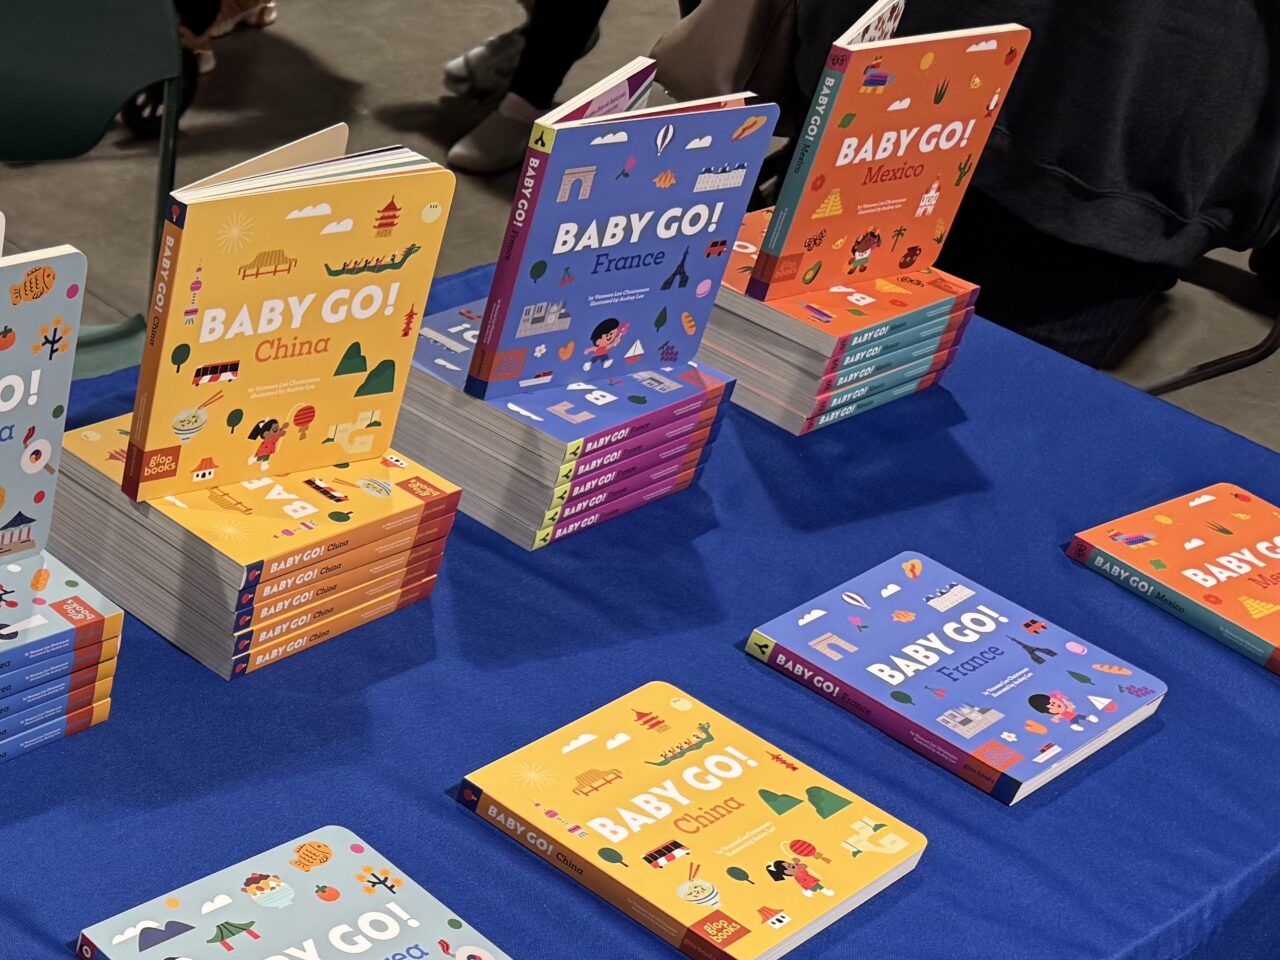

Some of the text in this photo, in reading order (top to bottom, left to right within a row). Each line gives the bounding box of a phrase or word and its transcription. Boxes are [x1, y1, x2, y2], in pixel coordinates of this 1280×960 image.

[795, 76, 835, 174] BABY GO! Mexico
[836, 119, 976, 167] BABY GO!
[861, 161, 925, 186] Mexico
[513, 156, 540, 227] BABY GO!
[552, 202, 724, 255] BABY GO!
[590, 250, 665, 275] France
[150, 235, 174, 346] BABY GO! China
[198, 282, 400, 343] BABY GO!
[255, 337, 331, 363] China
[852, 326, 889, 345] BABY GO!
[843, 346, 882, 365] BABY GO!
[837, 365, 875, 386] BABY GO!
[585, 436, 610, 452] BABY
[611, 428, 629, 442] GO!
[144, 463, 176, 476] books
[149, 453, 172, 467] glop
[578, 459, 603, 475] BABY
[603, 450, 621, 465] GO!
[572, 471, 615, 496] BABY GO!
[270, 540, 349, 573] BABY GO! China
[1181, 547, 1267, 588] BABY
[263, 563, 342, 597] BABY GO! China
[1095, 556, 1184, 613] BABY GO! Mexico
[260, 584, 337, 618] BABY GO! China
[259, 607, 334, 642] BABY GO! China
[866, 632, 955, 686] BABY
[942, 605, 1010, 643] GO!
[776, 652, 814, 681] BABY
[813, 673, 840, 696] GO!
[937, 644, 1005, 683] France
[586, 777, 694, 844] BABY
[682, 745, 759, 791] GO!
[672, 796, 746, 837] China
[488, 804, 583, 876] BABY GO! China
[326, 901, 421, 956] GO!
[704, 920, 728, 935] glop
[709, 922, 740, 942] books
